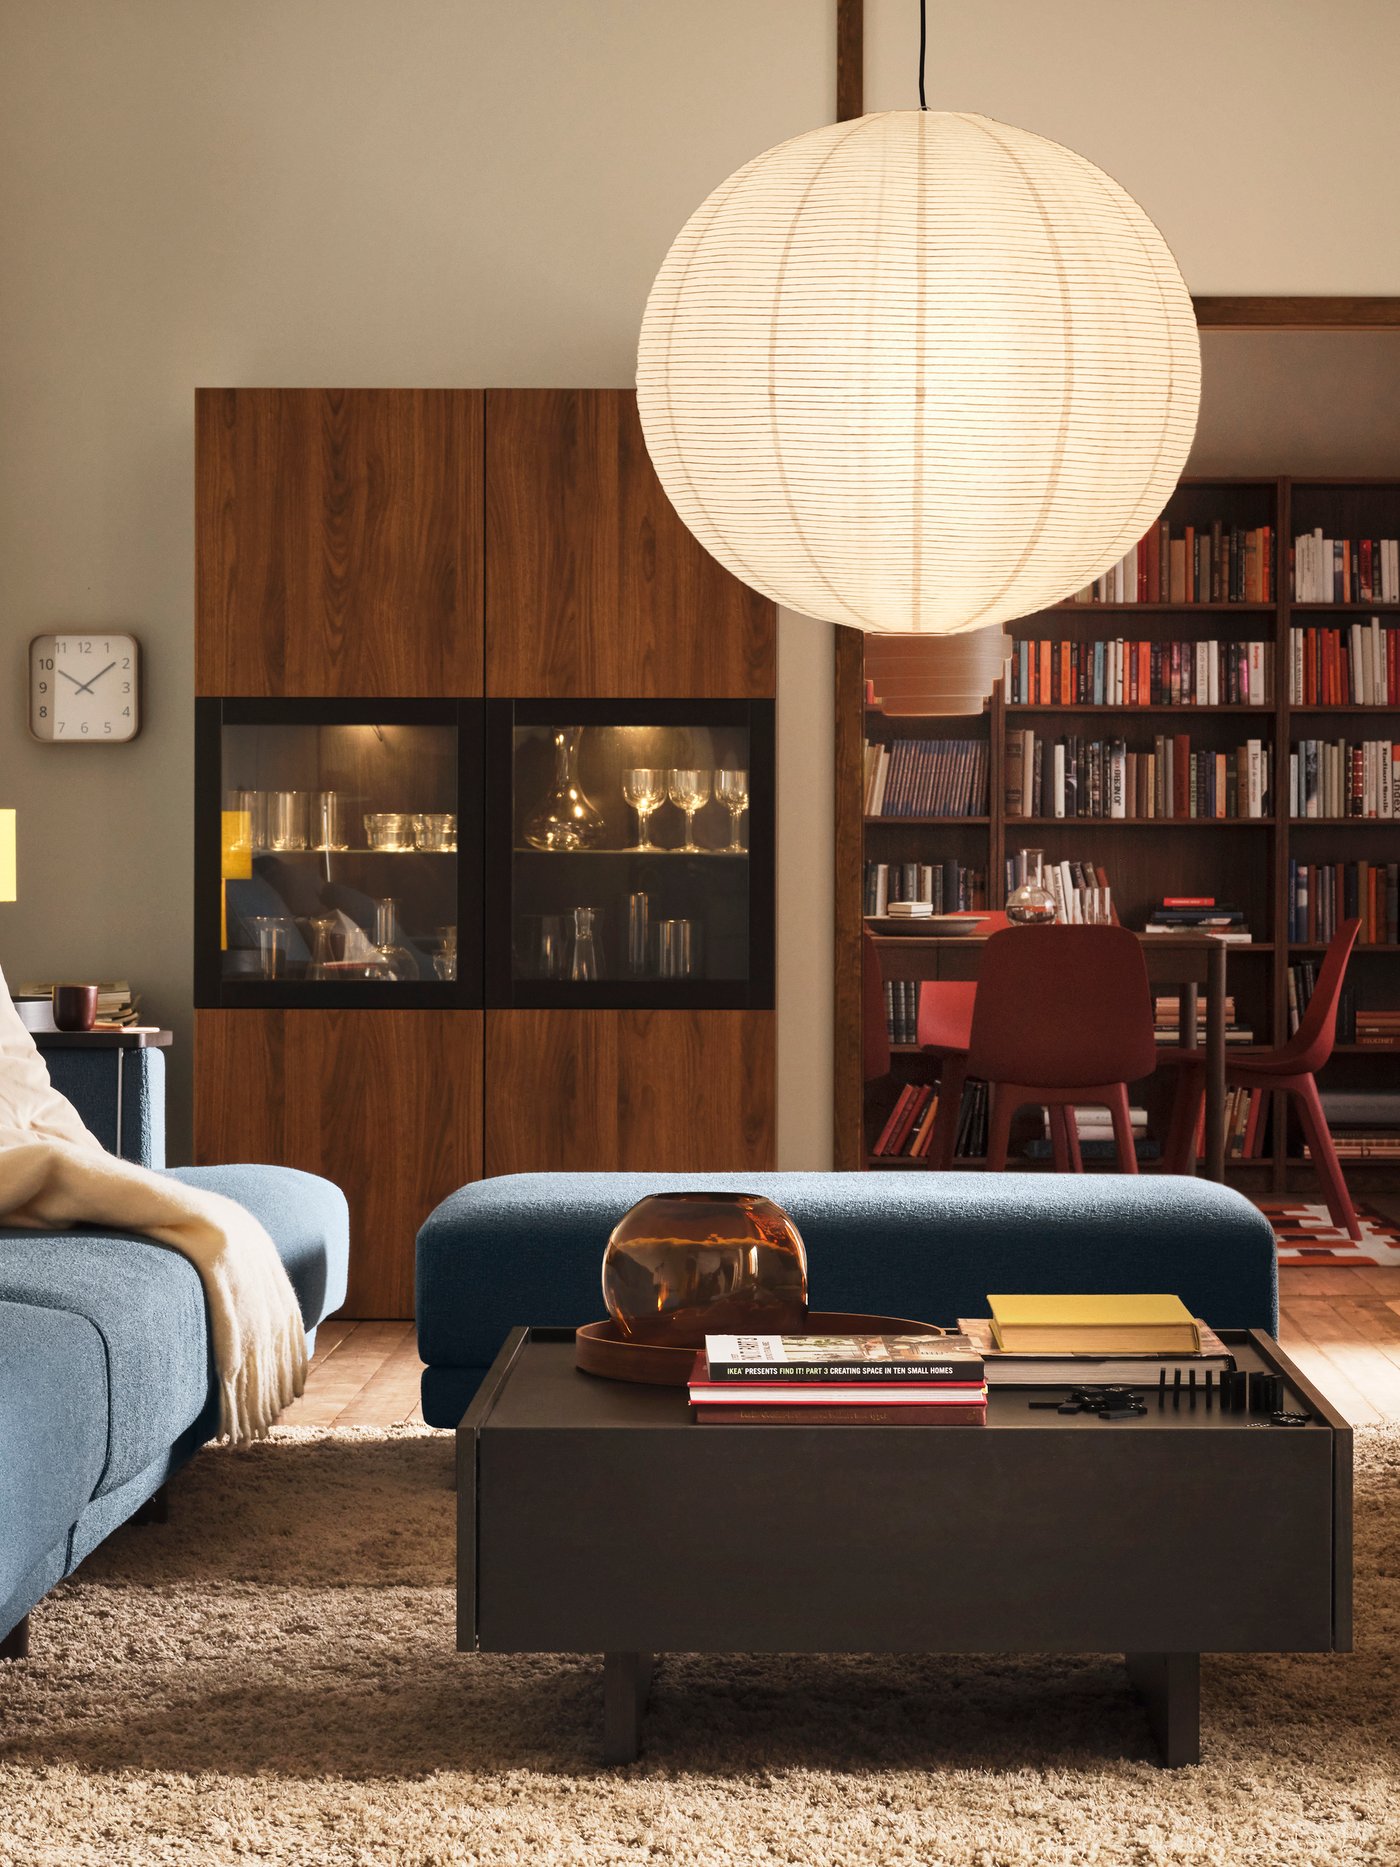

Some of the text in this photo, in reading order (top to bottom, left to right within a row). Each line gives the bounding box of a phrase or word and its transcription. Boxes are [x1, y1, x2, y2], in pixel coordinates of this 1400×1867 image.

[56, 642, 67, 653] 11
[78, 642, 92, 653] 12
[104, 642, 110, 653] 1
[39, 659, 54, 670] 10
[122, 658, 130, 669] 2
[39, 682, 47, 694] 9
[122, 682, 130, 693] 3
[39, 706, 47, 718] 8
[122, 706, 130, 718] 4
[58, 722, 65, 733] 7
[81, 722, 89, 734] 6
[104, 722, 111, 733] 5
[727, 1367, 953, 1375] IKEA PRESENTS FIND IT! PART 3 CREATING SPACE IN TEN SMALL HOMES
